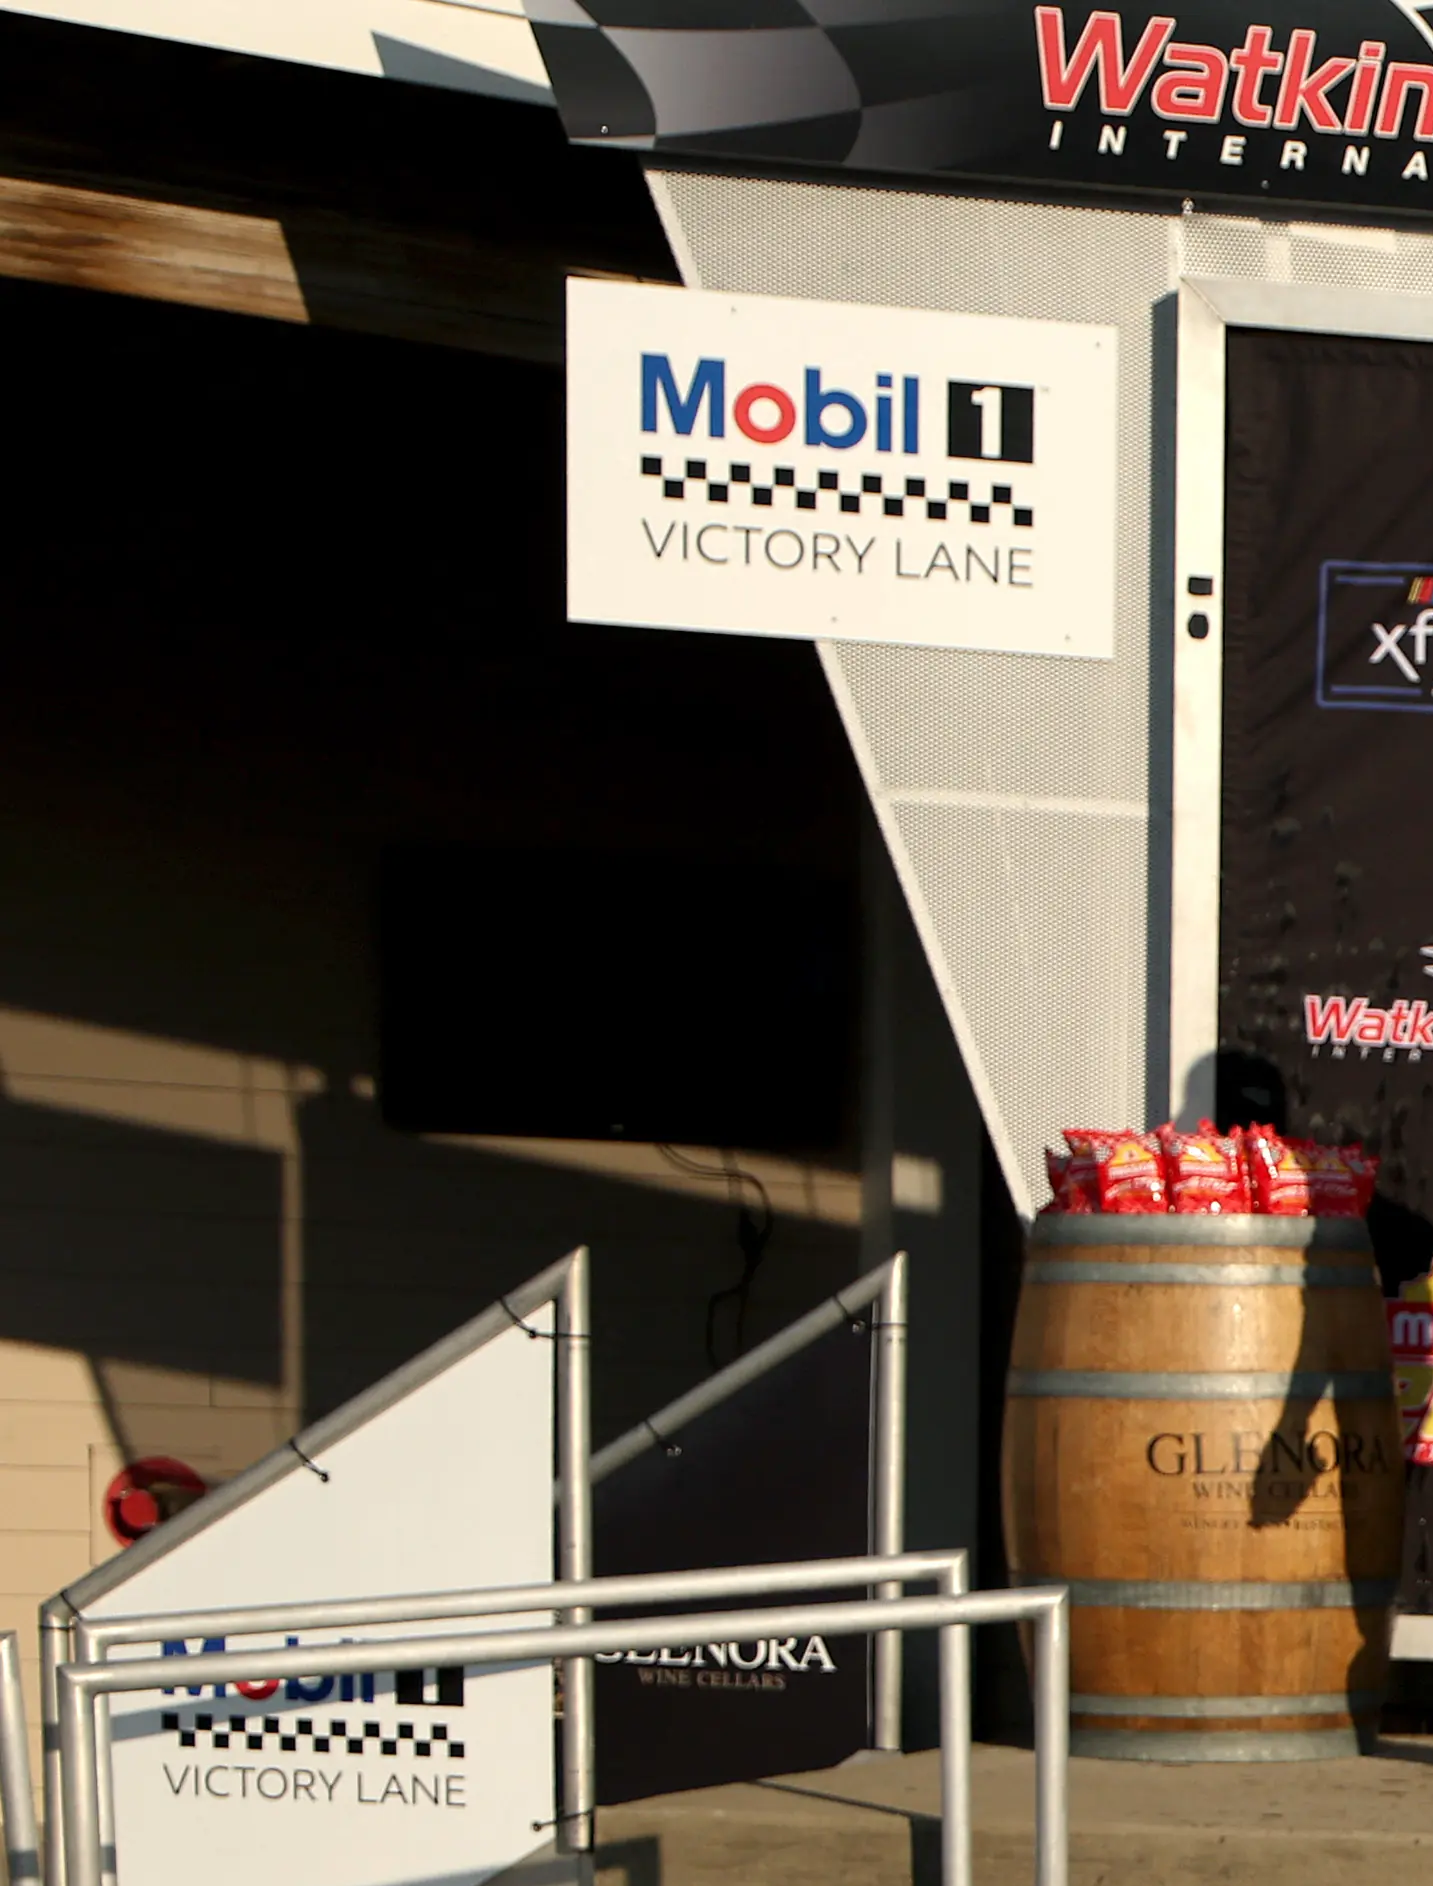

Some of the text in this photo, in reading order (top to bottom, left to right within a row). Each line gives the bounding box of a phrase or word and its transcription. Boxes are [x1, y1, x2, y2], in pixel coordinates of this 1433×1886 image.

[640, 352, 921, 457] Mobil
[641, 518, 1035, 589] VICTORY LANE
[1146, 1430, 1390, 1476] GLENORA
[639, 1669, 787, 1692] WINE CELLARS
[163, 1763, 467, 1807] VICTORY LANE
